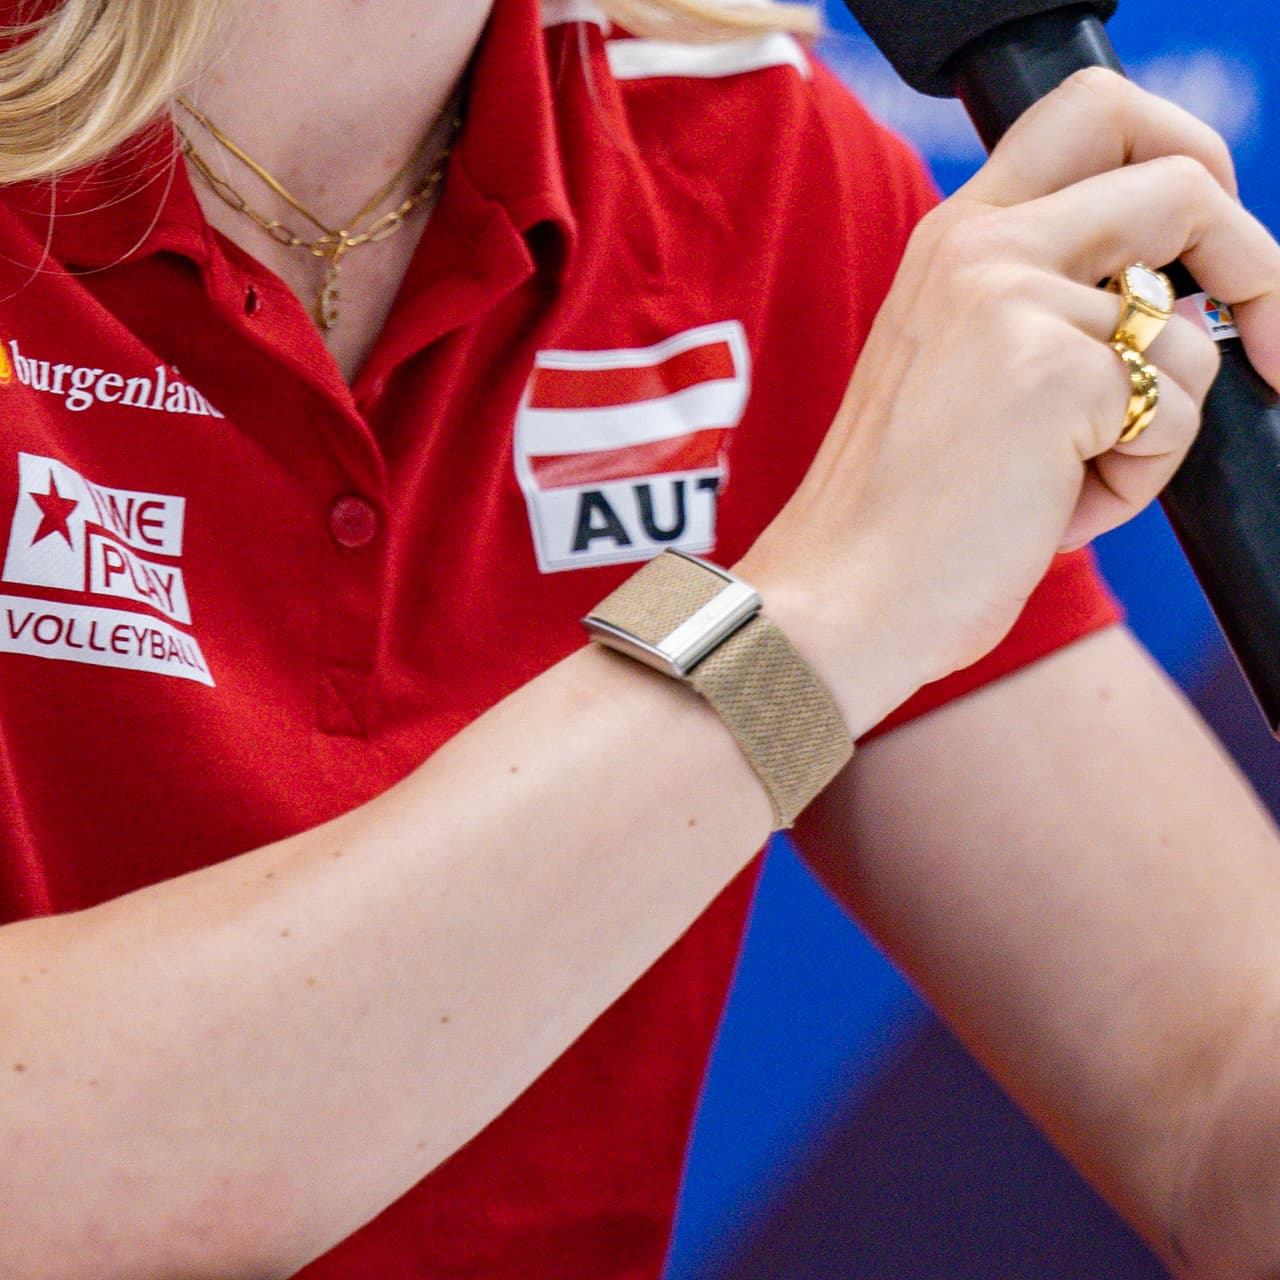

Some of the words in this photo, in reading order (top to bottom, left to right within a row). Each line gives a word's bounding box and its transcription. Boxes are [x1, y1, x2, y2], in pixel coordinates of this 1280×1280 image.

[86, 480, 166, 547] WE
[102, 542, 175, 613] PLAY
[6, 608, 205, 671] VOLLEYBALL
